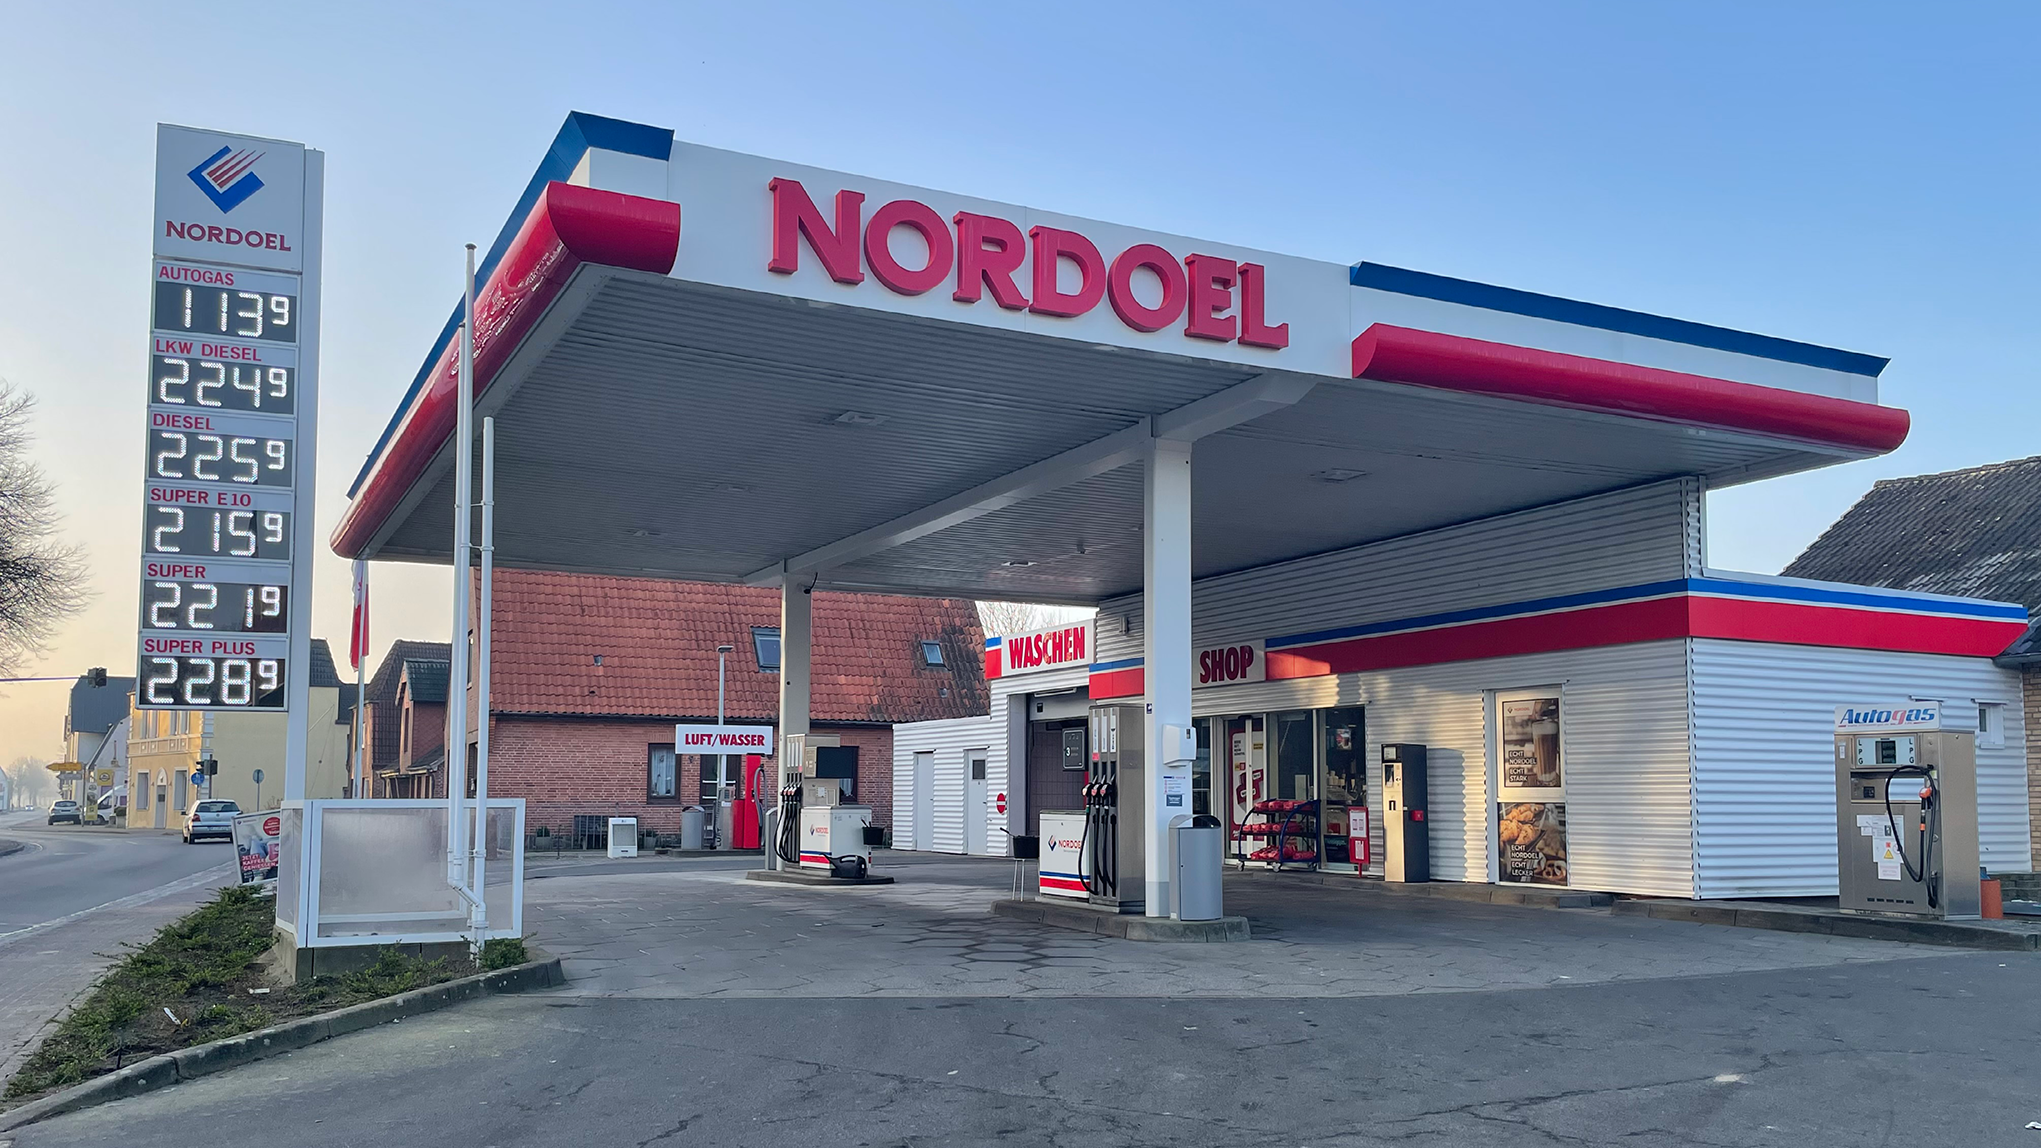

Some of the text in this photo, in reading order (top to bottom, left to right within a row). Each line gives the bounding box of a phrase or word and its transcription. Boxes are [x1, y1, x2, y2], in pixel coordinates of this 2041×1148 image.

[165, 220, 292, 252] NORDOEL
[766, 176, 1289, 350] NORDOEL
[158, 265, 235, 286] AUTOGAS
[155, 339, 262, 362] LKW DIESEL
[152, 413, 216, 431] DIESEL
[150, 487, 252, 507] SUPER E10
[147, 563, 207, 579] SUPER
[144, 638, 256, 656] SUPER PLUS
[1008, 626, 1086, 670] WASCHEN
[1199, 645, 1255, 684] SHOP
[1839, 708, 1937, 725] Autogas
[684, 733, 766, 748] LUFT/WASSER
[1058, 839, 1081, 849] NORDOE
[1511, 851, 1539, 859] NORDOEL
